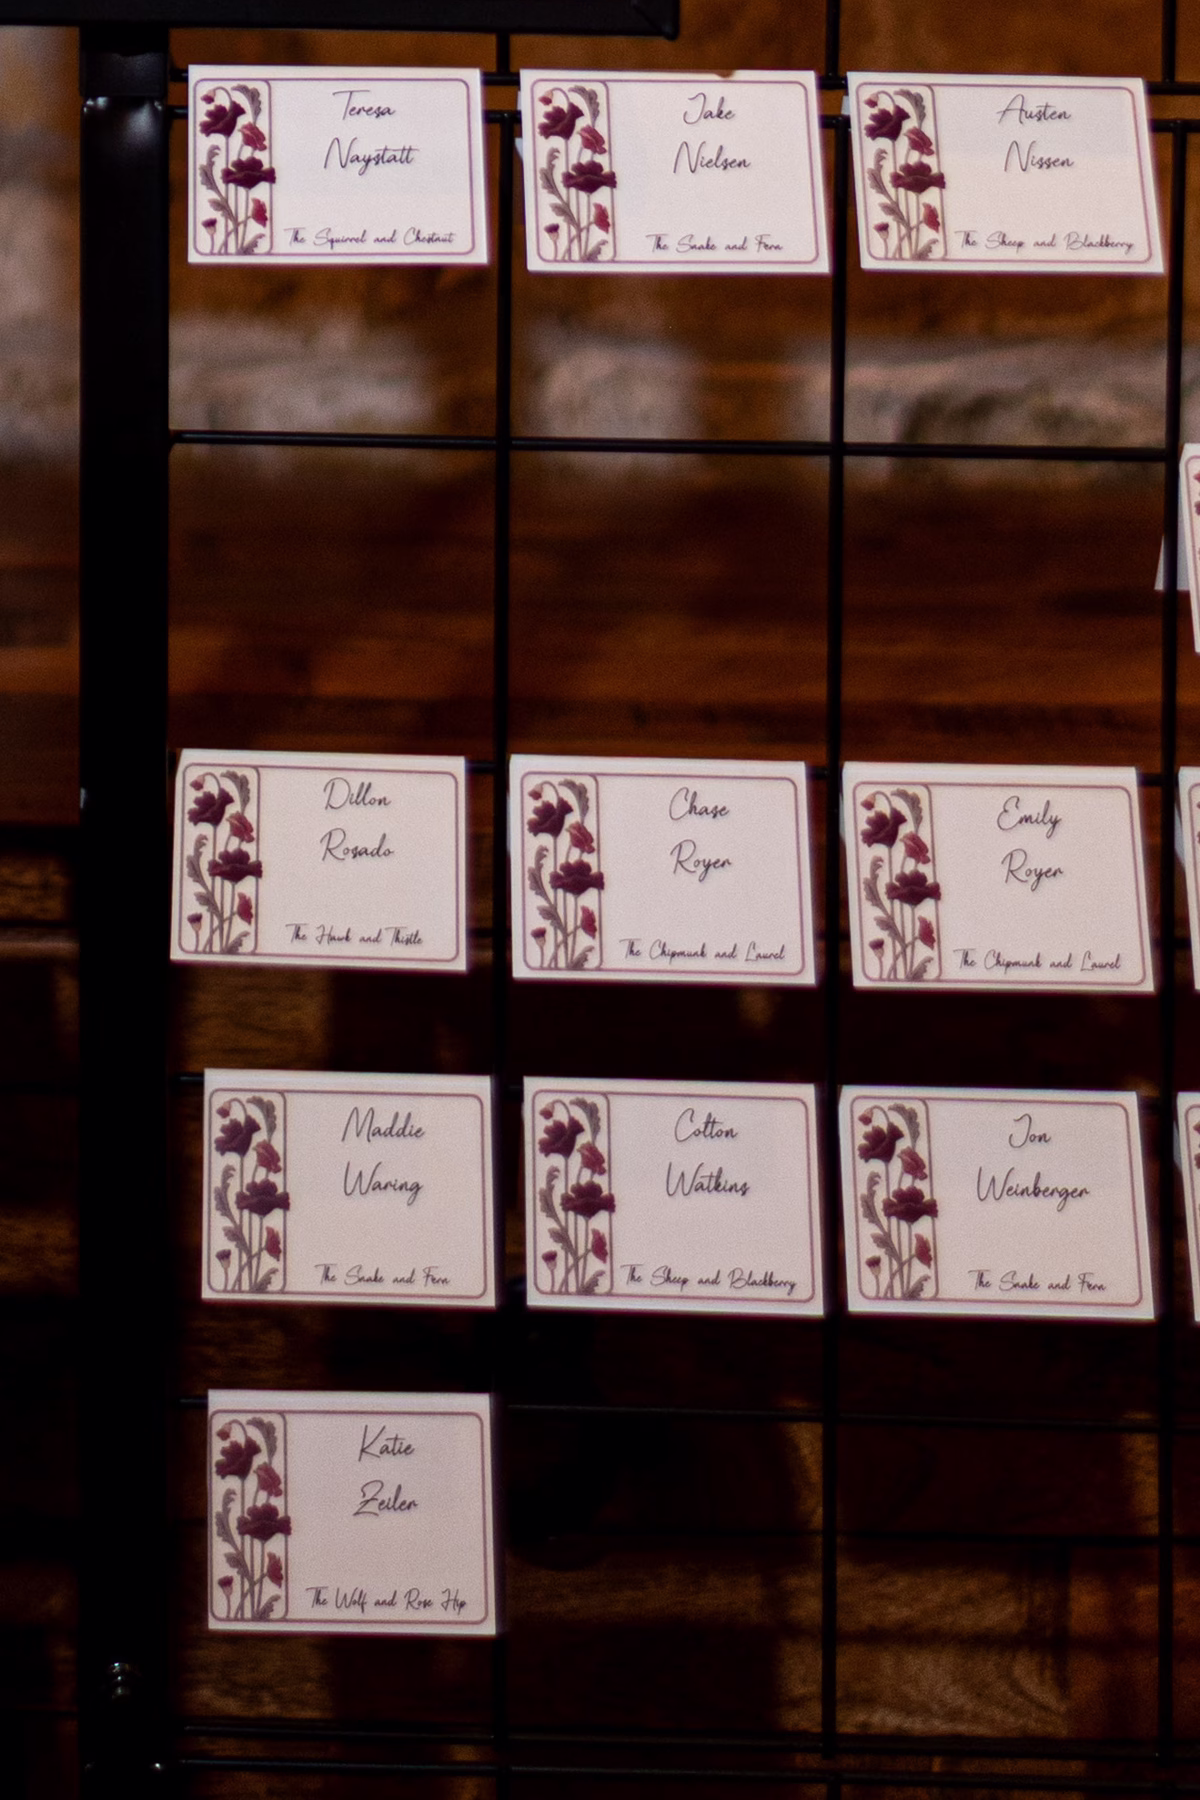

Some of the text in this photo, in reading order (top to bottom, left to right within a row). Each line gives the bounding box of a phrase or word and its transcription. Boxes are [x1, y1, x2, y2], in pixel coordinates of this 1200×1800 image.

[332, 89, 396, 120] Teresa
[682, 92, 736, 125] Jake
[998, 93, 1072, 125] Austen
[323, 136, 418, 177] Naystatt
[672, 140, 751, 175] Nielsen
[1003, 139, 1075, 173] Nissen
[284, 226, 455, 251] The Squirrel and Chestnut
[646, 233, 784, 252] The Snake and Fern
[955, 230, 1135, 255] The Sheep and Blackberry
[322, 776, 392, 811] Dillon
[668, 786, 730, 822] Chase
[996, 795, 1063, 840] Emily
[319, 827, 395, 862] Rosado
[669, 839, 733, 884] Royer
[1000, 848, 1064, 893] Royer
[286, 923, 423, 947] The Hawk and Thistle
[620, 938, 786, 964] The Chipmunk and Laurel
[954, 948, 1122, 975] The Chipmunk and Laurel
[341, 1106, 426, 1144] Maddie
[674, 1107, 739, 1144] Colton
[1008, 1112, 1052, 1149] Jon
[343, 1161, 424, 1208] Waring
[665, 1162, 750, 1198] Watkins
[976, 1166, 1091, 1214] Weinberger
[314, 1262, 450, 1287] The Snake and Fern
[619, 1264, 798, 1297] The Sheep and Blackberry
[969, 1269, 1107, 1293] The Snake and Fern
[357, 1424, 416, 1463] Katie
[352, 1479, 419, 1517] Zeiler
[305, 1586, 468, 1616] The Wolf and Rose Hip
